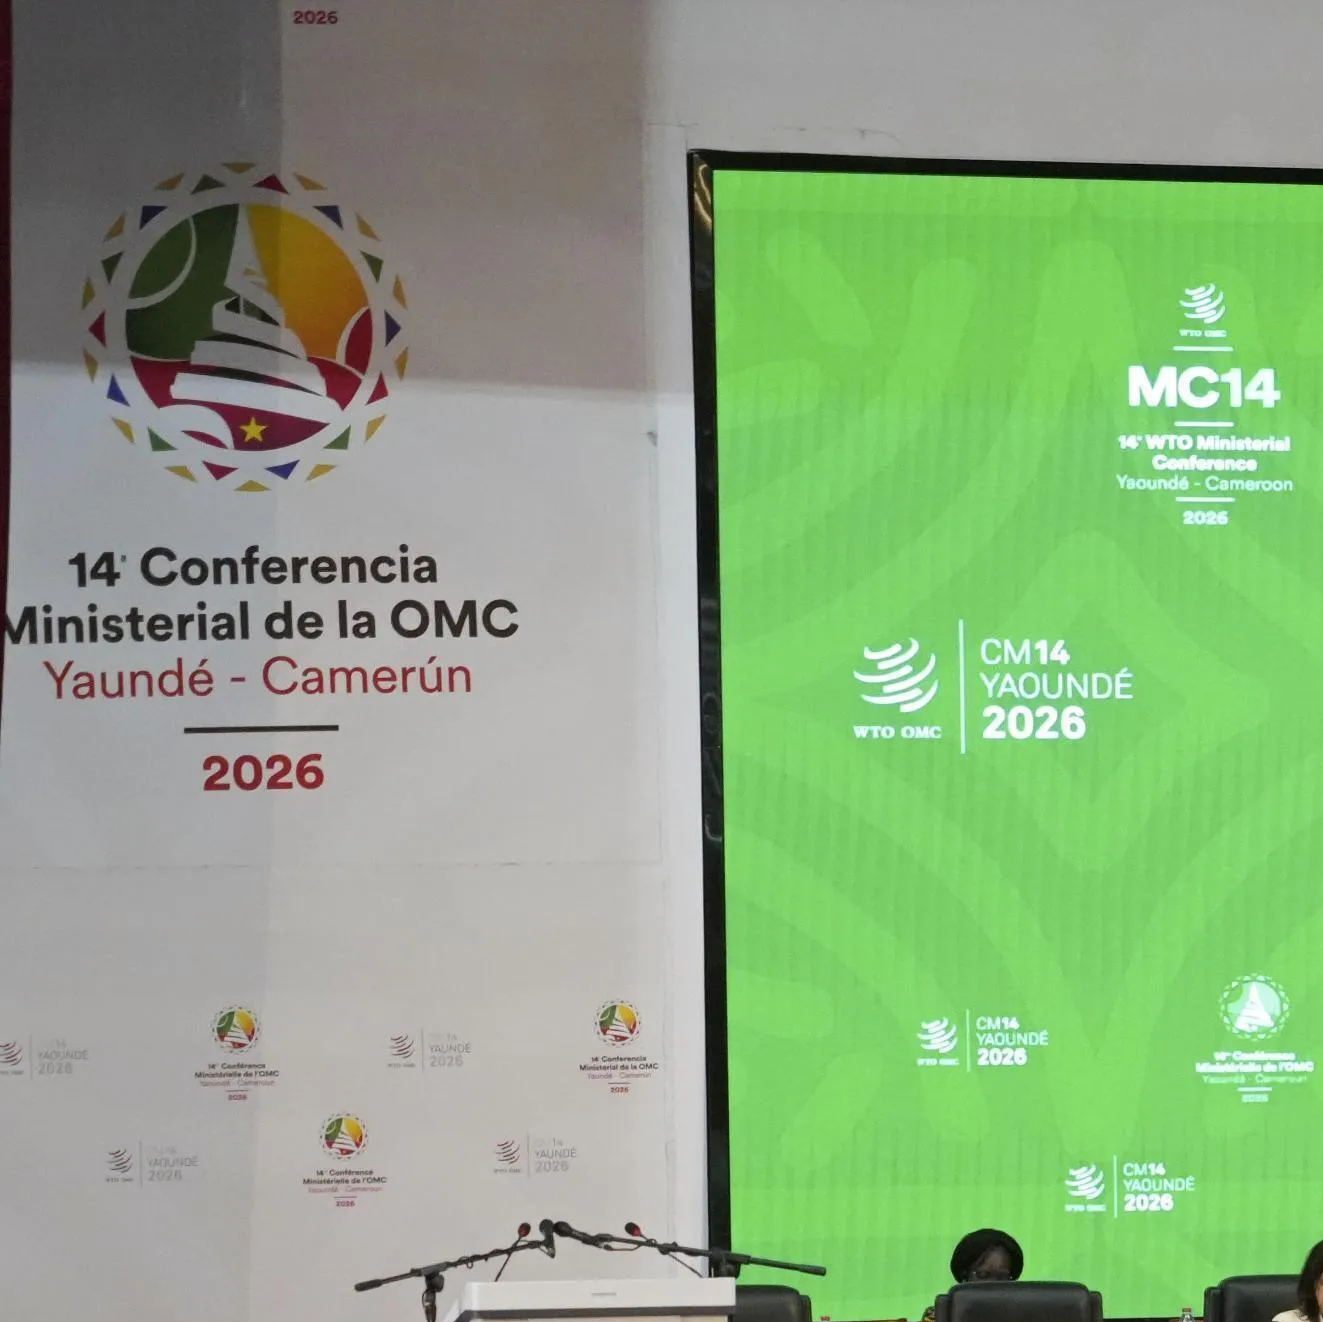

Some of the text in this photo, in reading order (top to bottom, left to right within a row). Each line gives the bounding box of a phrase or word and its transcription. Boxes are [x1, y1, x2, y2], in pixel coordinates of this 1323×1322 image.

[294, 11, 338, 24] 2026
[1129, 366, 1280, 408] MC14
[1145, 435, 1193, 450] WTO
[1197, 436, 1290, 451] Ministerial
[1152, 454, 1257, 471] Conference
[1116, 475, 1189, 490] Yaoundé
[1205, 476, 1293, 491] Cameroon
[1184, 511, 1228, 524] 2026
[141, 544, 437, 586] Conferencia
[3, 599, 518, 645] Ministerial de la OMC
[981, 639, 1070, 664] CM14
[43, 657, 213, 699] Yaundé
[263, 656, 471, 695] Camerún
[980, 668, 1133, 699] YAOUNDÉ
[983, 705, 1086, 739] 2026
[854, 726, 941, 738] WTO OMC
[203, 754, 324, 791] 2026
[977, 1017, 1020, 1030] CM14
[976, 1028, 1048, 1049] YAOUNDÉ
[430, 1055, 463, 1067] 2026
[978, 1048, 1027, 1065] 2026
[536, 1160, 569, 1172] 2026
[1123, 1163, 1165, 1176] CM14
[1124, 1174, 1194, 1192] YAOUNDÉ
[1125, 1193, 1173, 1211] 2026
